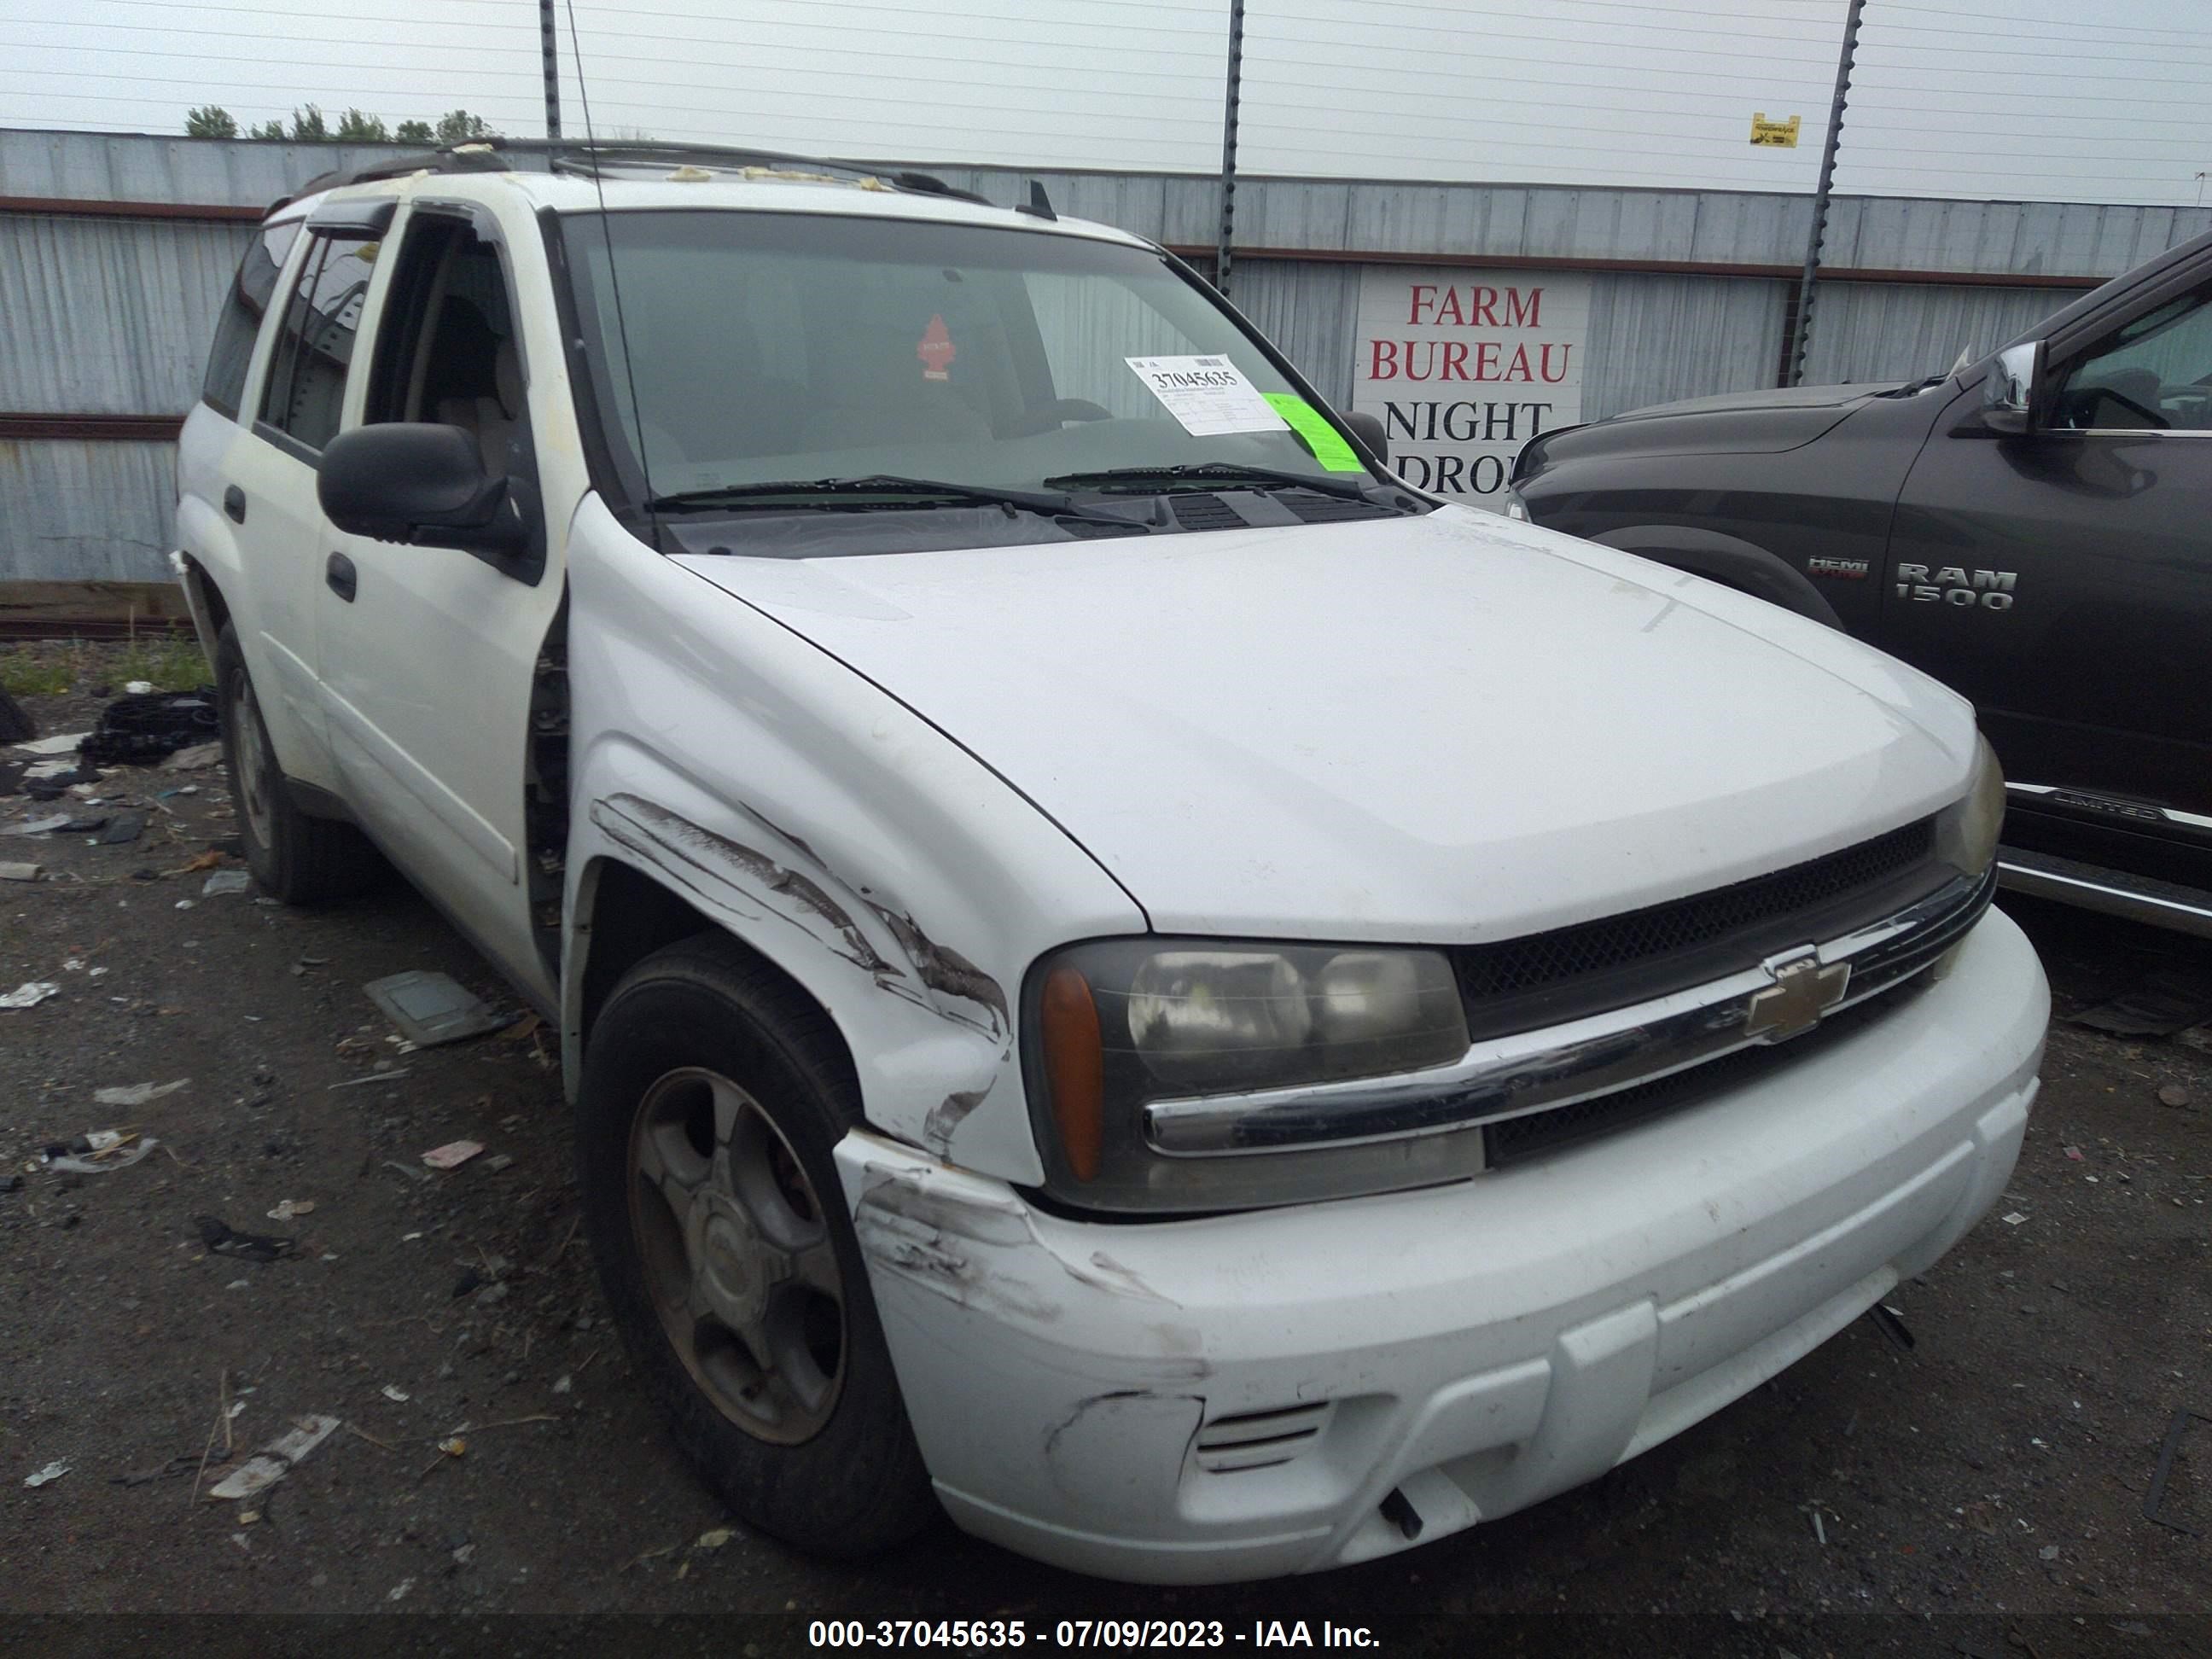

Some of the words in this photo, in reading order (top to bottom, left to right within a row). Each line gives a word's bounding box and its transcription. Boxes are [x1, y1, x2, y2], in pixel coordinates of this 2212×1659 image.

[1406, 284, 1545, 329] FARM
[1368, 339, 1573, 383] BUREAU
[1152, 370, 1237, 389] 37045635
[1383, 401, 1552, 441] NIGHT
[1808, 557, 1870, 573] HEMI
[1896, 562, 2018, 591] RAM
[1895, 583, 2014, 609] 1500
